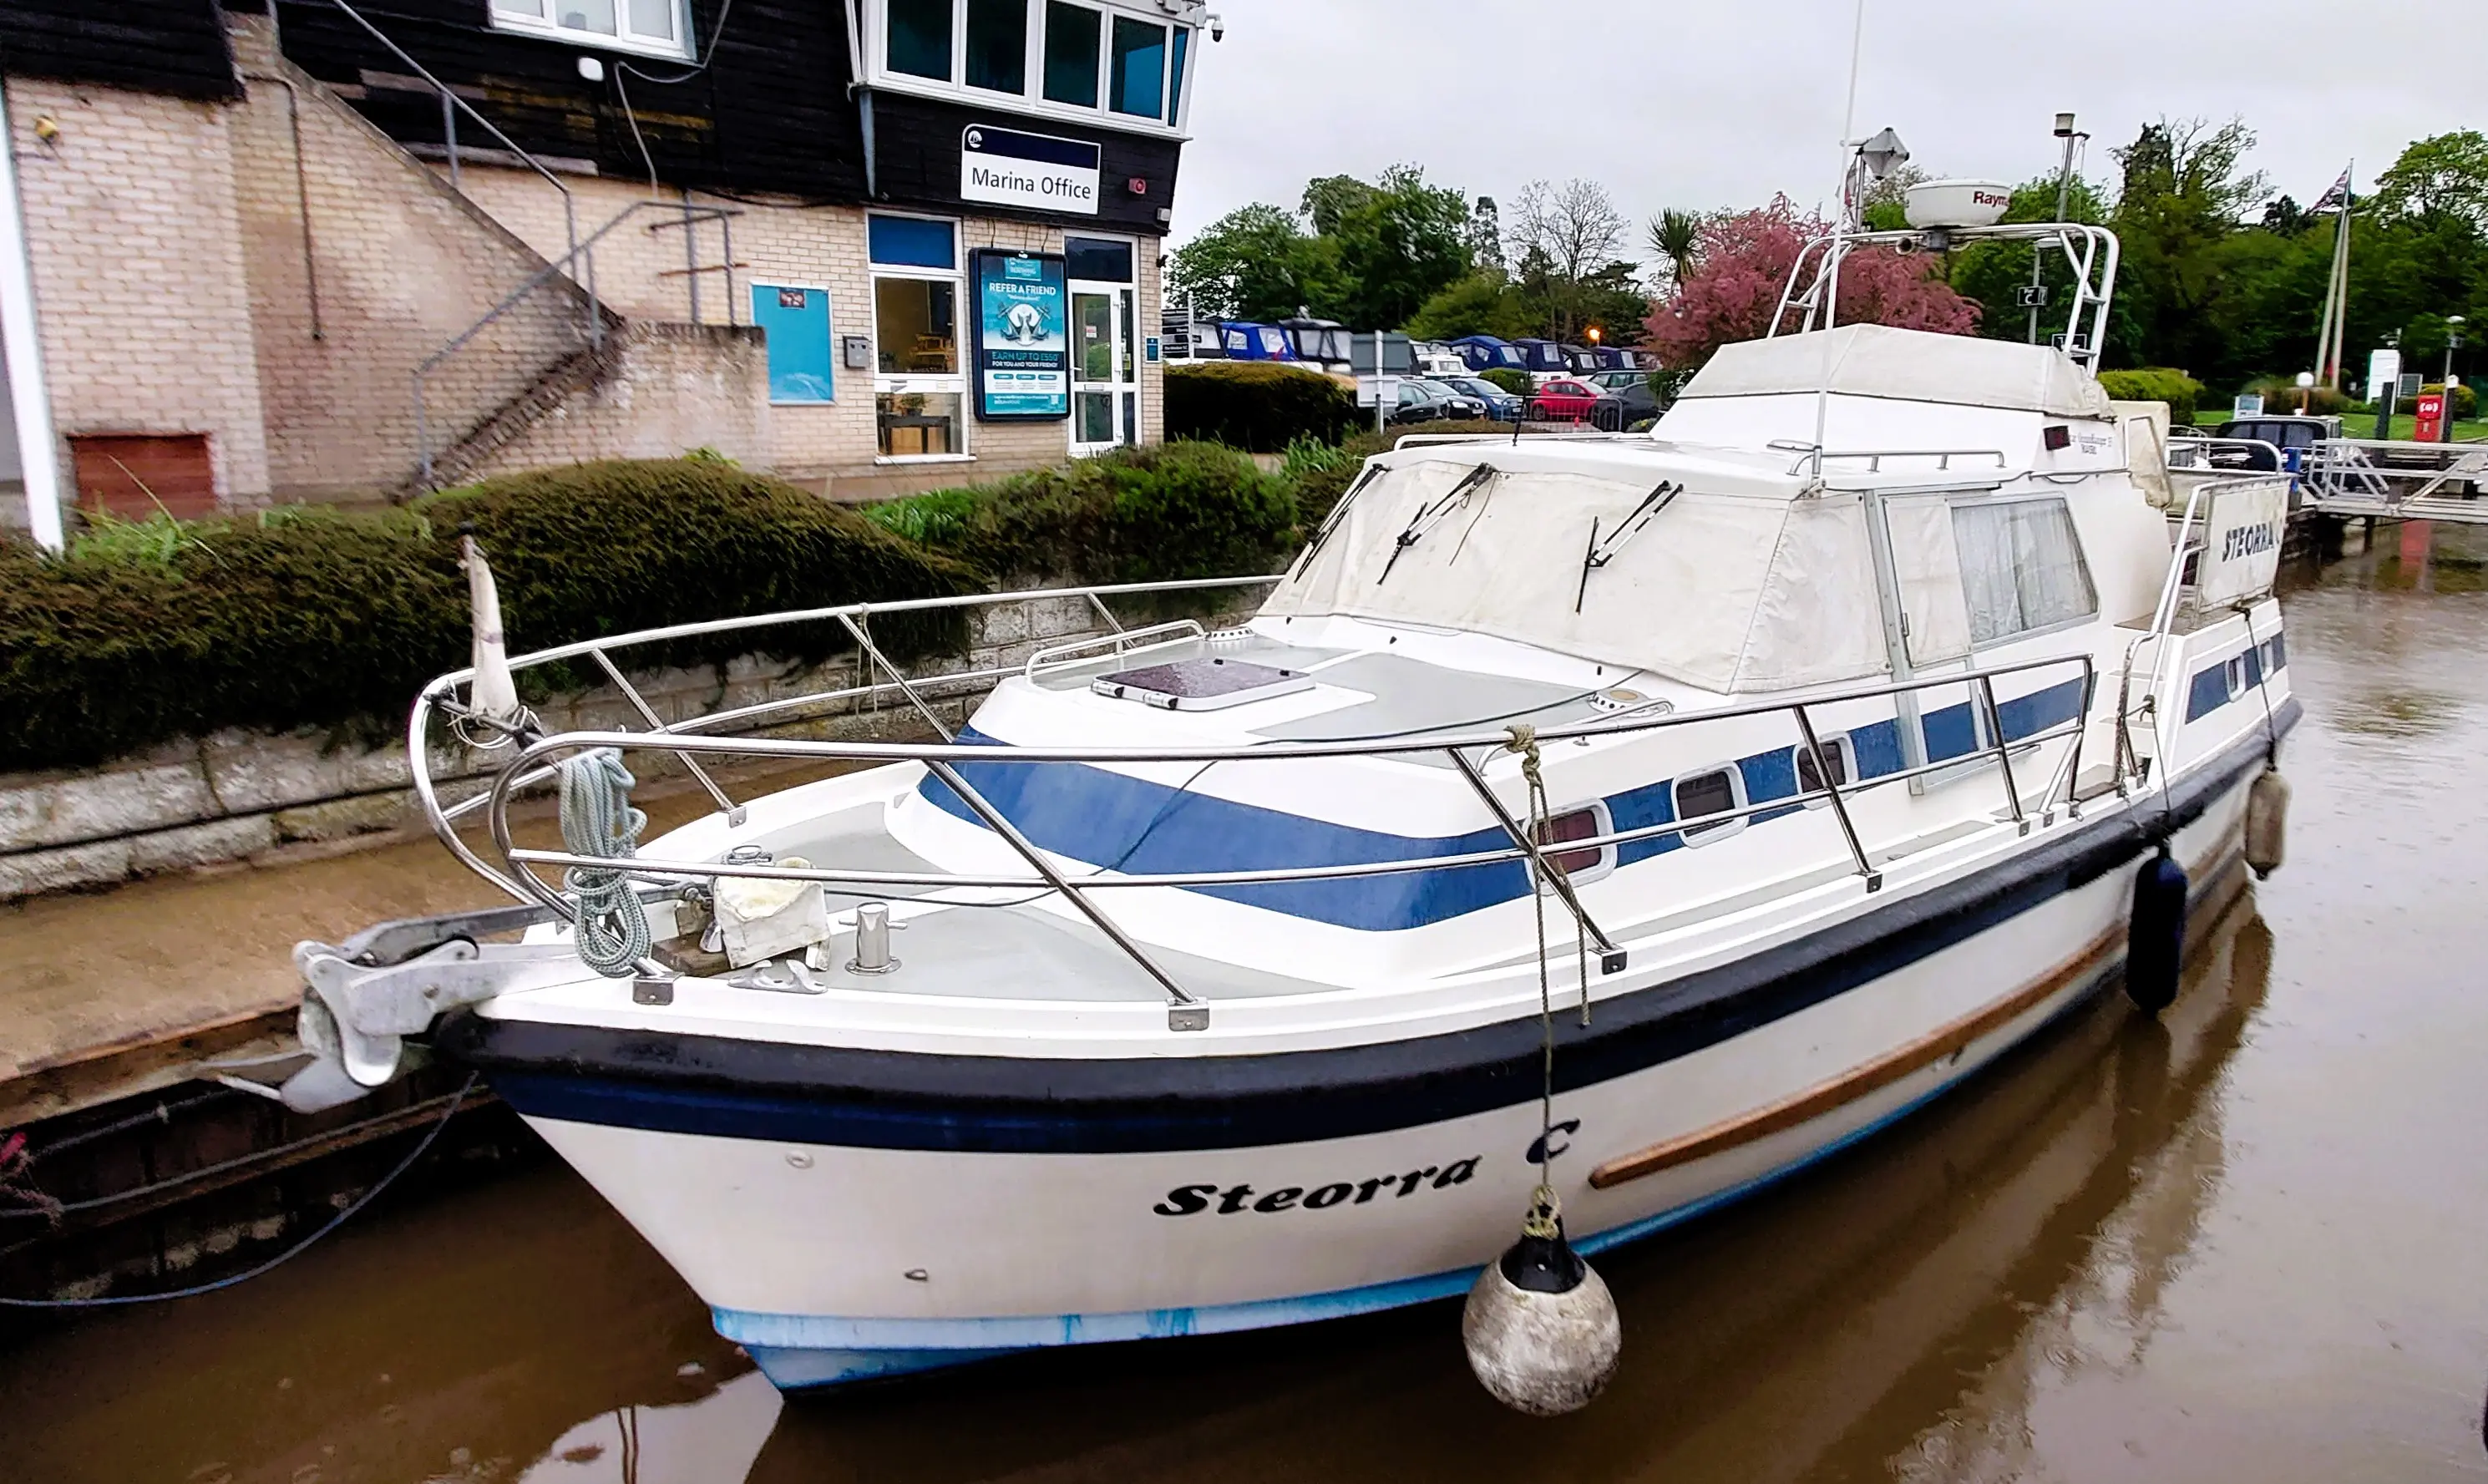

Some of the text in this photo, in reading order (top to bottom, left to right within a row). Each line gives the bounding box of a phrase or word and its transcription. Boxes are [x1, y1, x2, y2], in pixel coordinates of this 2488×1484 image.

[972, 167, 1091, 200] Marina Office
[989, 282, 1057, 296] REFER A FRIEND
[992, 352, 1015, 360] EARN
[1016, 352, 1026, 361] UP
[1028, 352, 1040, 361] TO
[2222, 521, 2274, 562] STEORRA
[1152, 1119, 1581, 1216] Steorra C
